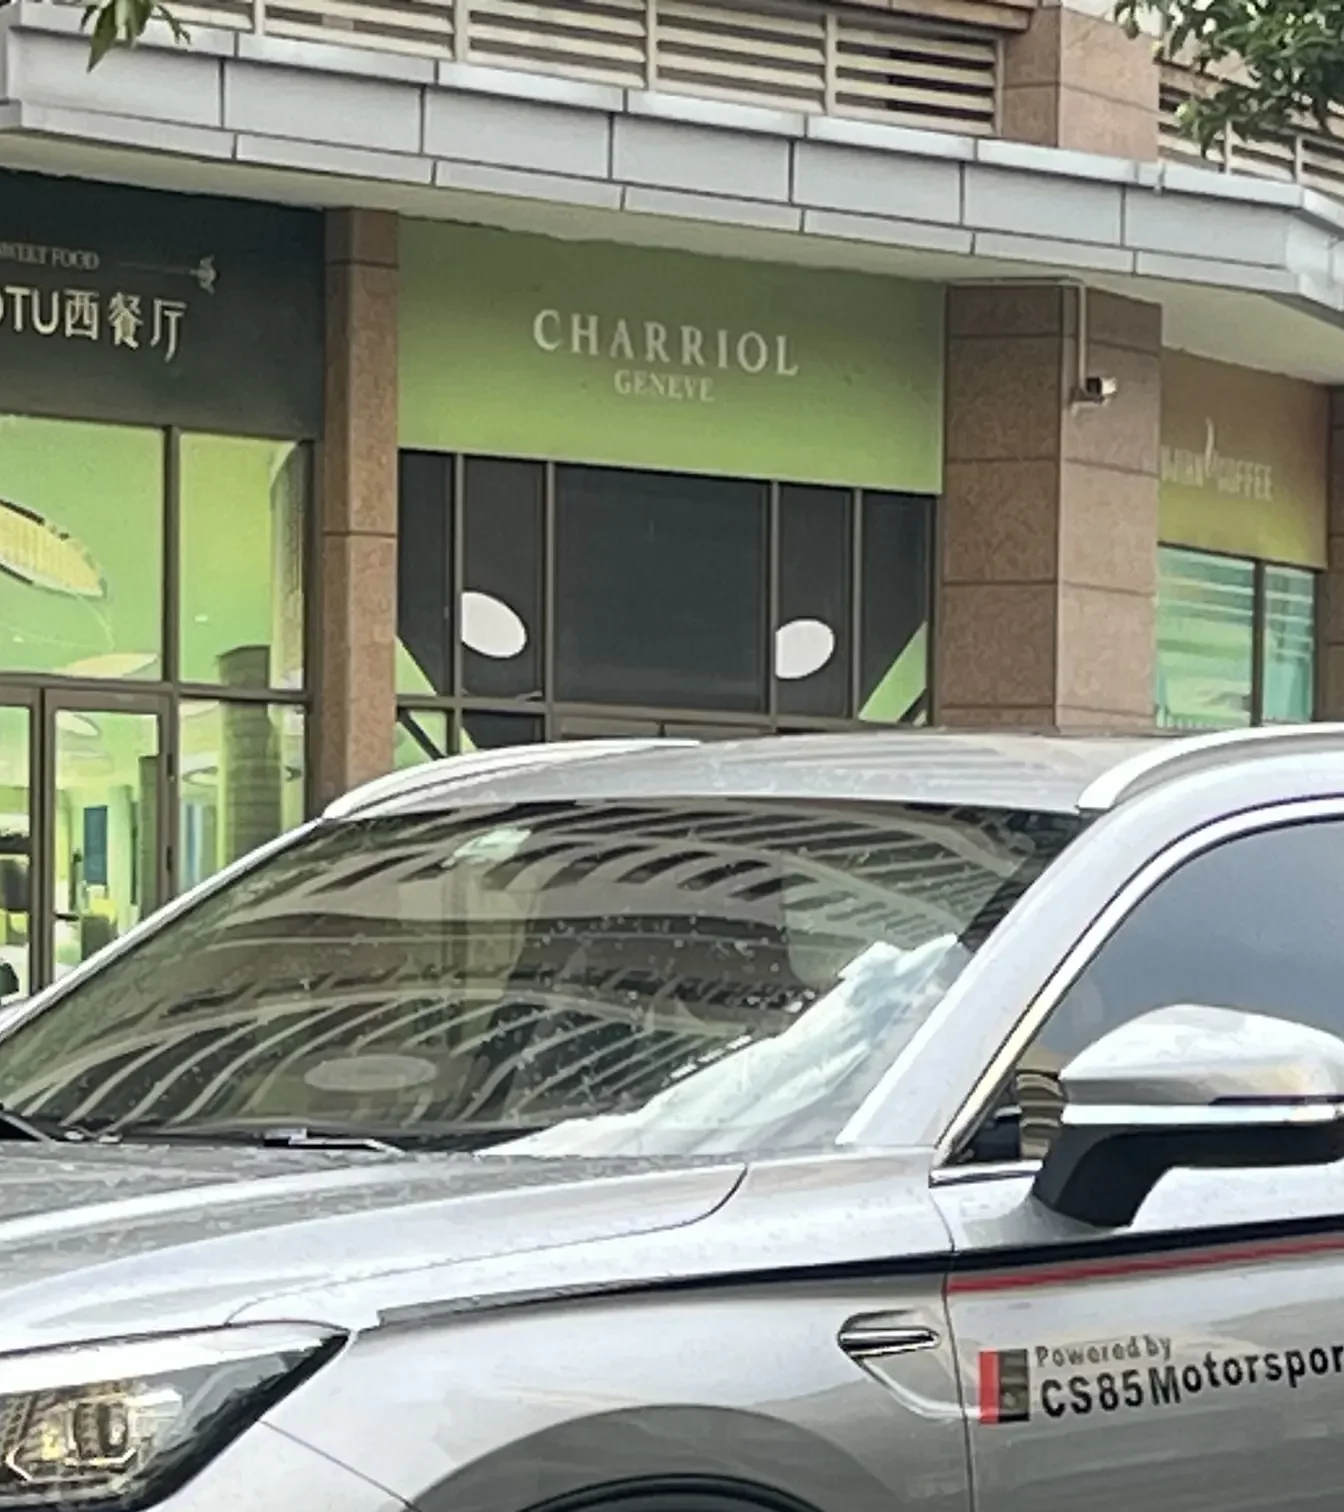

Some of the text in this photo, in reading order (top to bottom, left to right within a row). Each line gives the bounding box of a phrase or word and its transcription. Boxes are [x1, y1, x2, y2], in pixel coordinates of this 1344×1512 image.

[533, 308, 800, 377] CHARRIOL
[1035, 1333, 1174, 1368] Powered by
